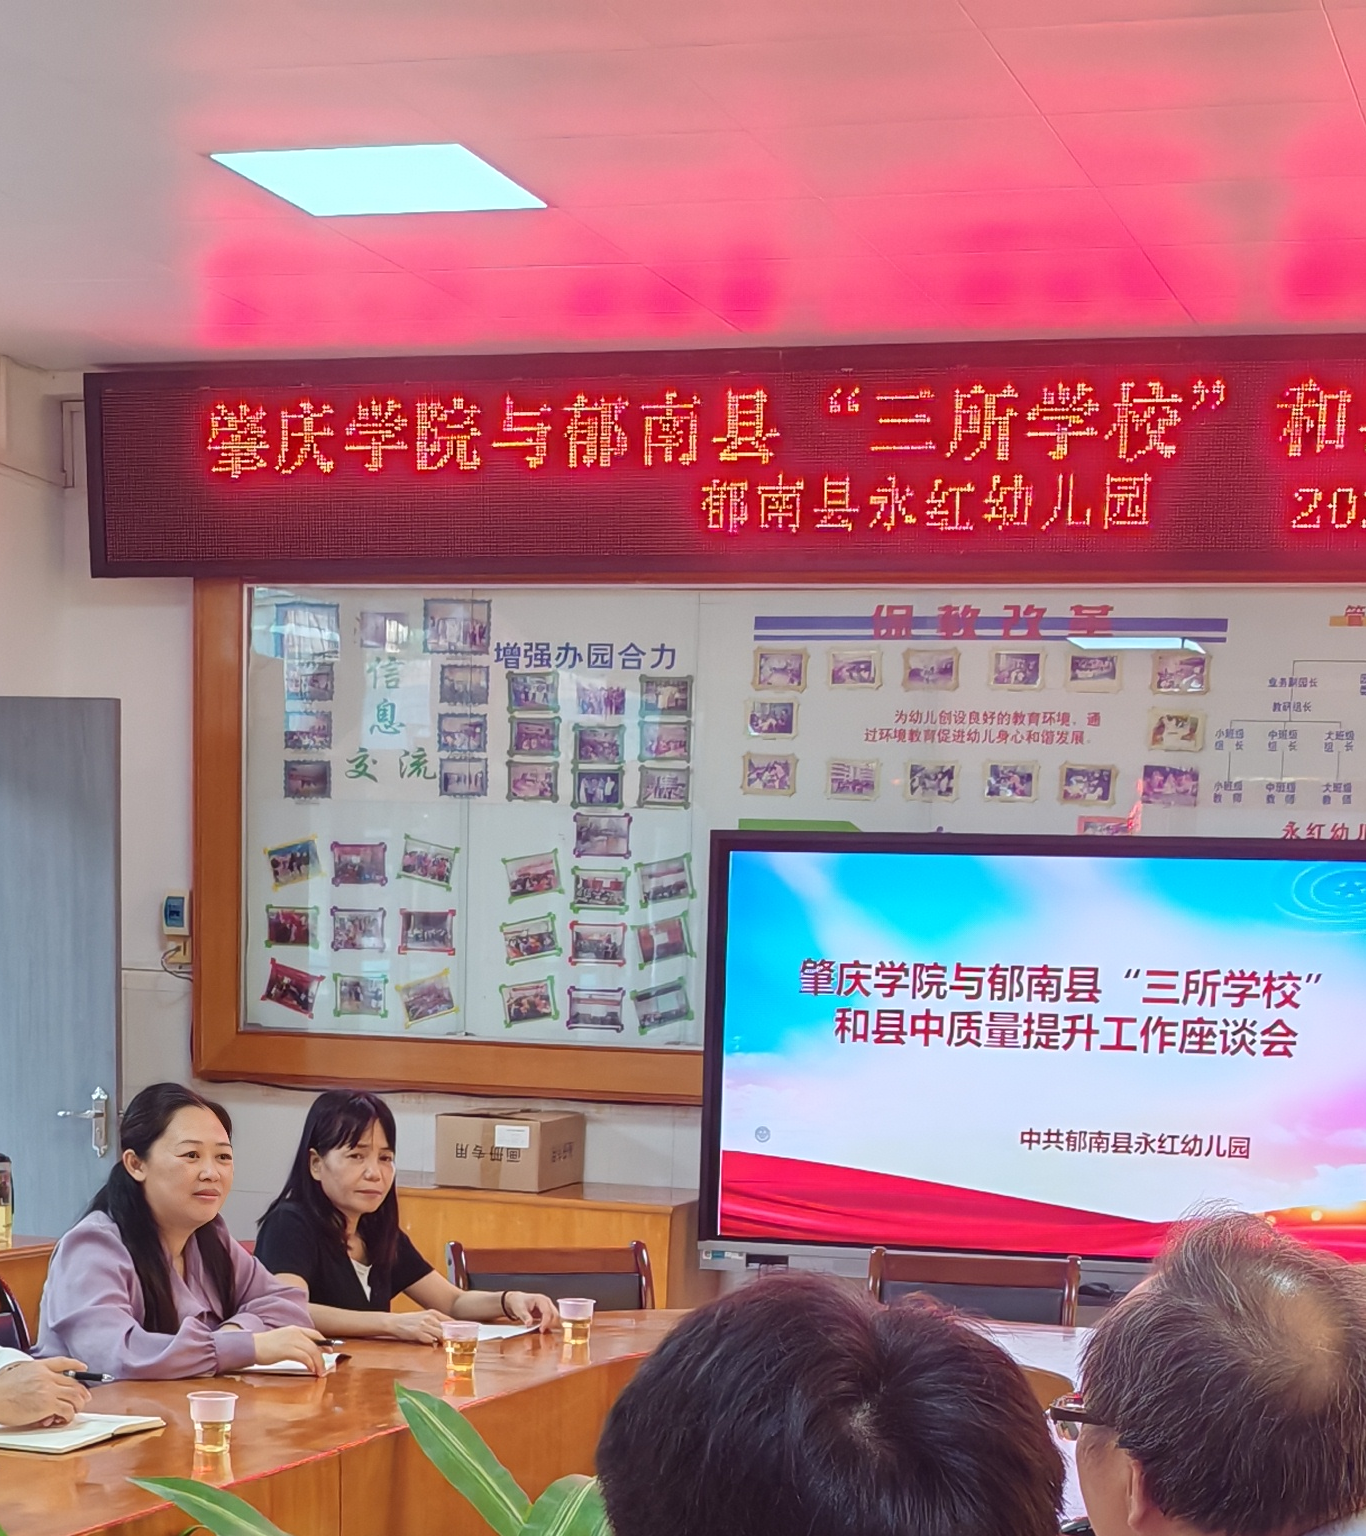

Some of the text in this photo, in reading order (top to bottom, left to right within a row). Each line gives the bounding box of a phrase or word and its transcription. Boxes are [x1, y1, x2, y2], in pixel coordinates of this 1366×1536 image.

[700, 472, 1152, 533] 郁南县永红幼儿园
[493, 642, 678, 671] 增强办园合力
[344, 747, 437, 783] 交流
[798, 957, 1323, 1011] 肇庆学院与郁南县“三所学校”
[834, 1008, 1298, 1058] 和县中质量提升工作座谈会
[1019, 1128, 1251, 1160] 中共郁南县永红幼儿园
